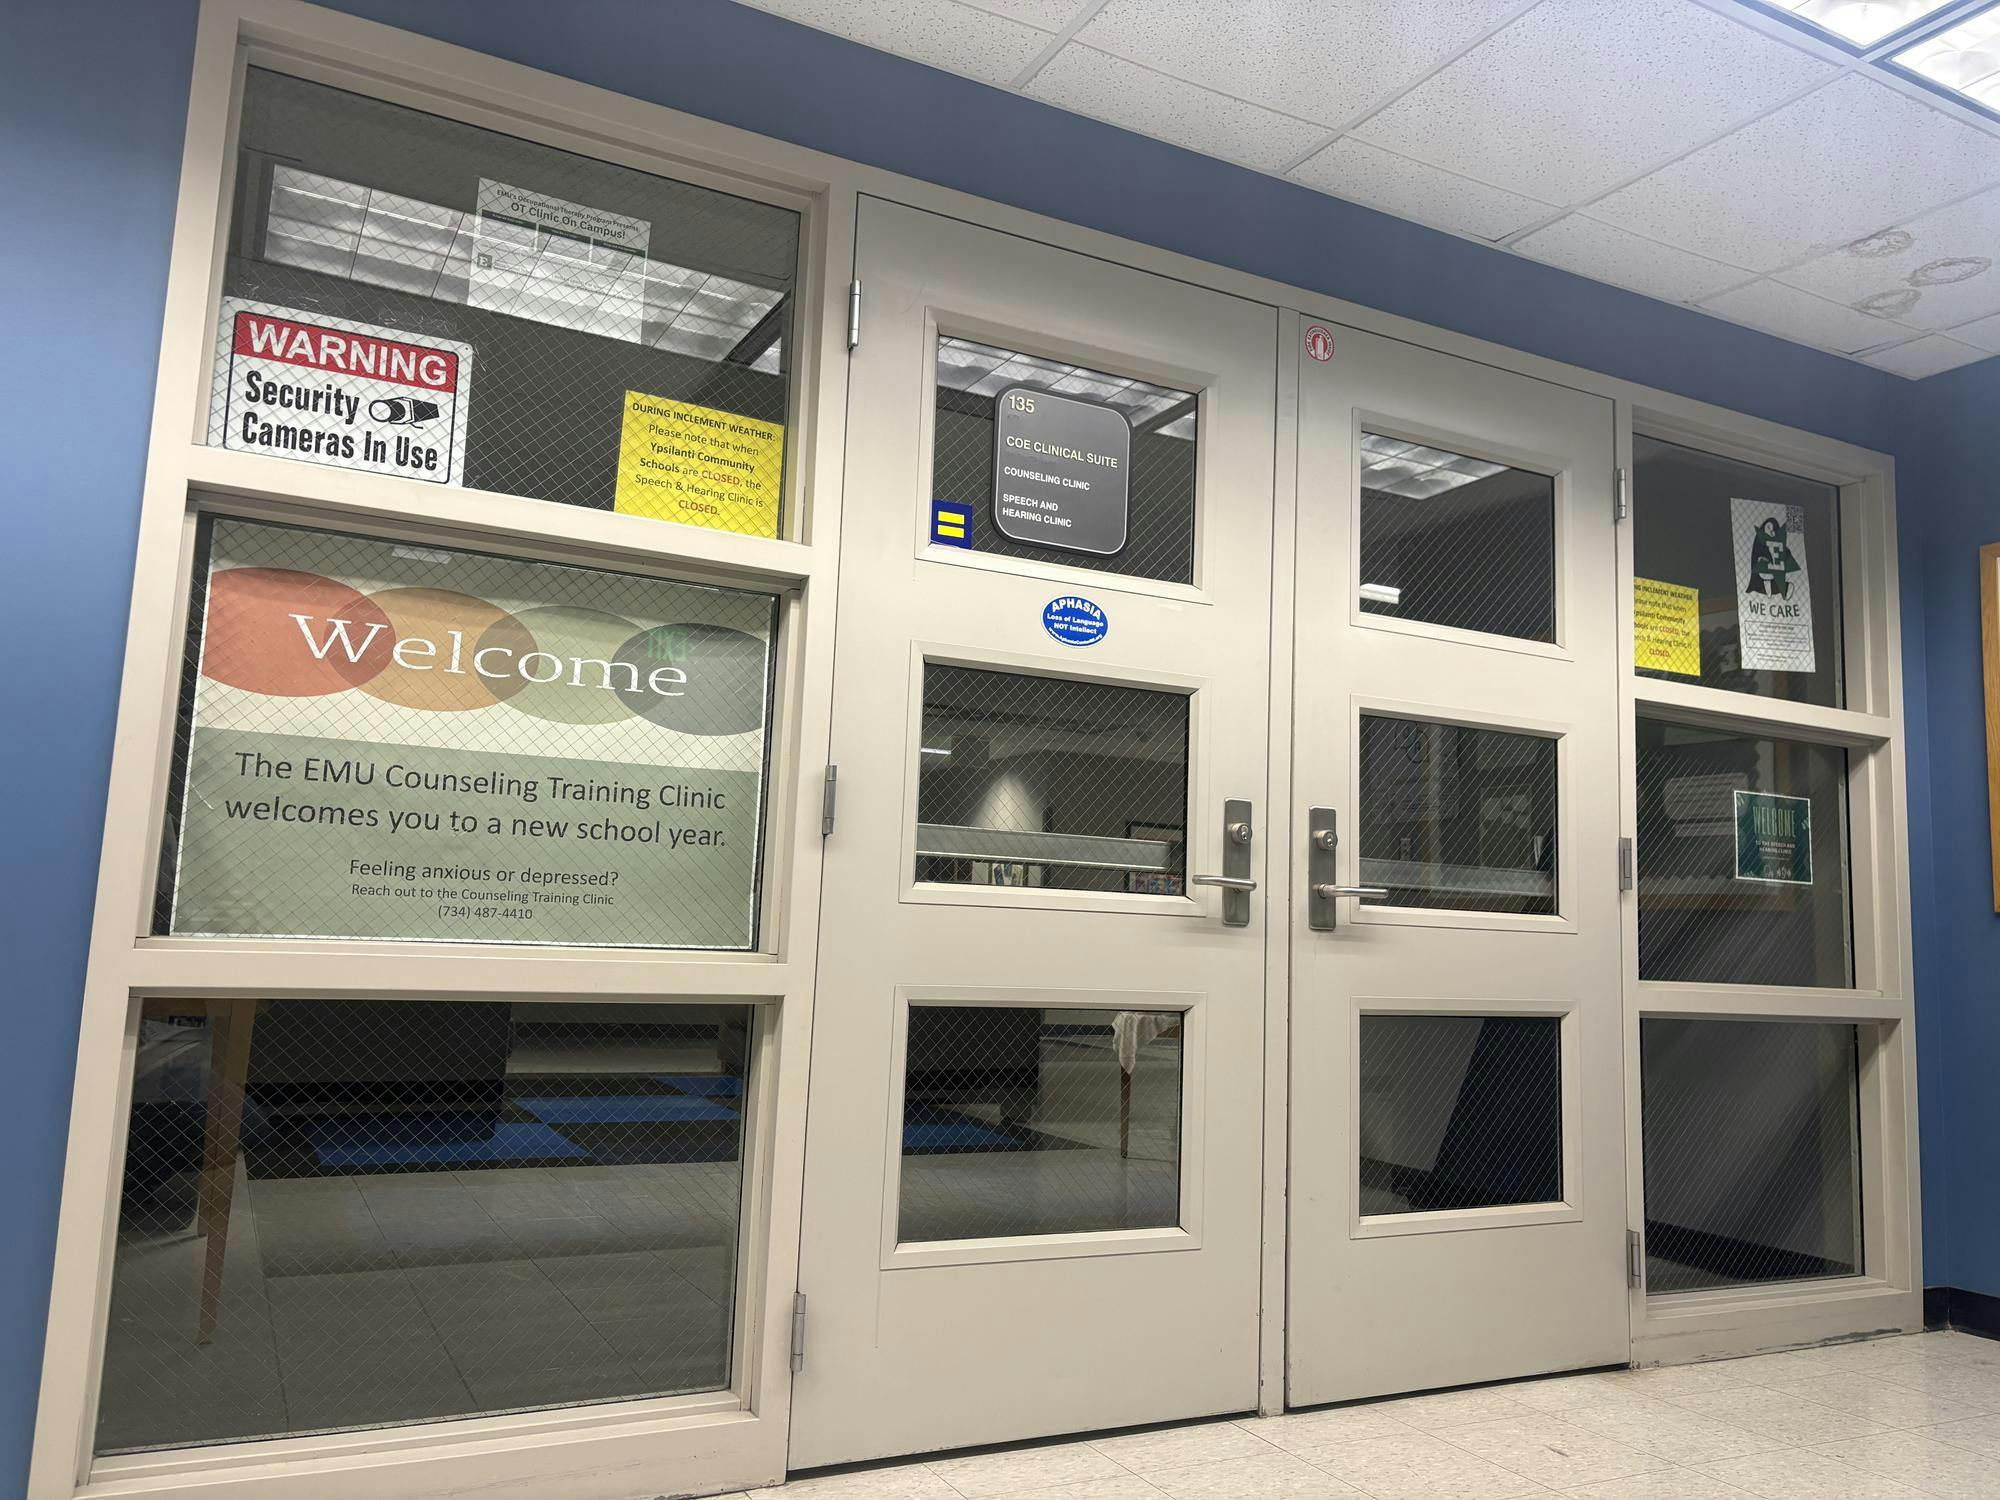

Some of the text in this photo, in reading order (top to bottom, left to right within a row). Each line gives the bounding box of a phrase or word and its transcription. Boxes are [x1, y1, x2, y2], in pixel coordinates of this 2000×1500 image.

[511, 202, 527, 213] OT
[529, 207, 560, 223] Clinic
[562, 216, 577, 227] On
[580, 220, 626, 239] Campus!
[586, 214, 612, 225] Program
[249, 320, 447, 386] WARNING
[245, 370, 360, 424] Security
[1008, 395, 1035, 413] 135
[632, 402, 776, 442] DURING INCLEMENT WEATHER:
[242, 411, 438, 471] Cameras In Use
[648, 424, 759, 456] Please note that when
[1006, 436, 1118, 468] COE CLINICAL SUITE
[650, 442, 755, 474] Ypsilanti Community
[639, 458, 762, 490] Schools are CLOSED, the
[1004, 466, 1091, 491] COUNSELING CLINIC
[635, 474, 764, 508] Speech & Hearing Clinic is
[1002, 494, 1059, 511] SPEECH AND
[678, 499, 721, 516] CLOSED.
[1002, 507, 1072, 528] HEARING CLINIC
[1765, 540, 1785, 571] E
[1046, 613, 1063, 621] Loss
[1072, 616, 1104, 628] Language
[1052, 598, 1101, 620] APHASIA
[1749, 600, 1800, 618] WE CARE
[1053, 622, 1098, 634] NOT Intellect
[289, 613, 689, 698] Welcome
[235, 752, 726, 810] The EMU Counseling Training Clinic
[225, 796, 726, 850] welcomes you to a new school year.
[1752, 806, 1796, 838] WELCOME
[349, 859, 619, 887] Feeling anxious or depressed?
[351, 884, 614, 906] Reach out to the Counseling Training Clinic
[438, 905, 533, 920] (734) 487-4410
